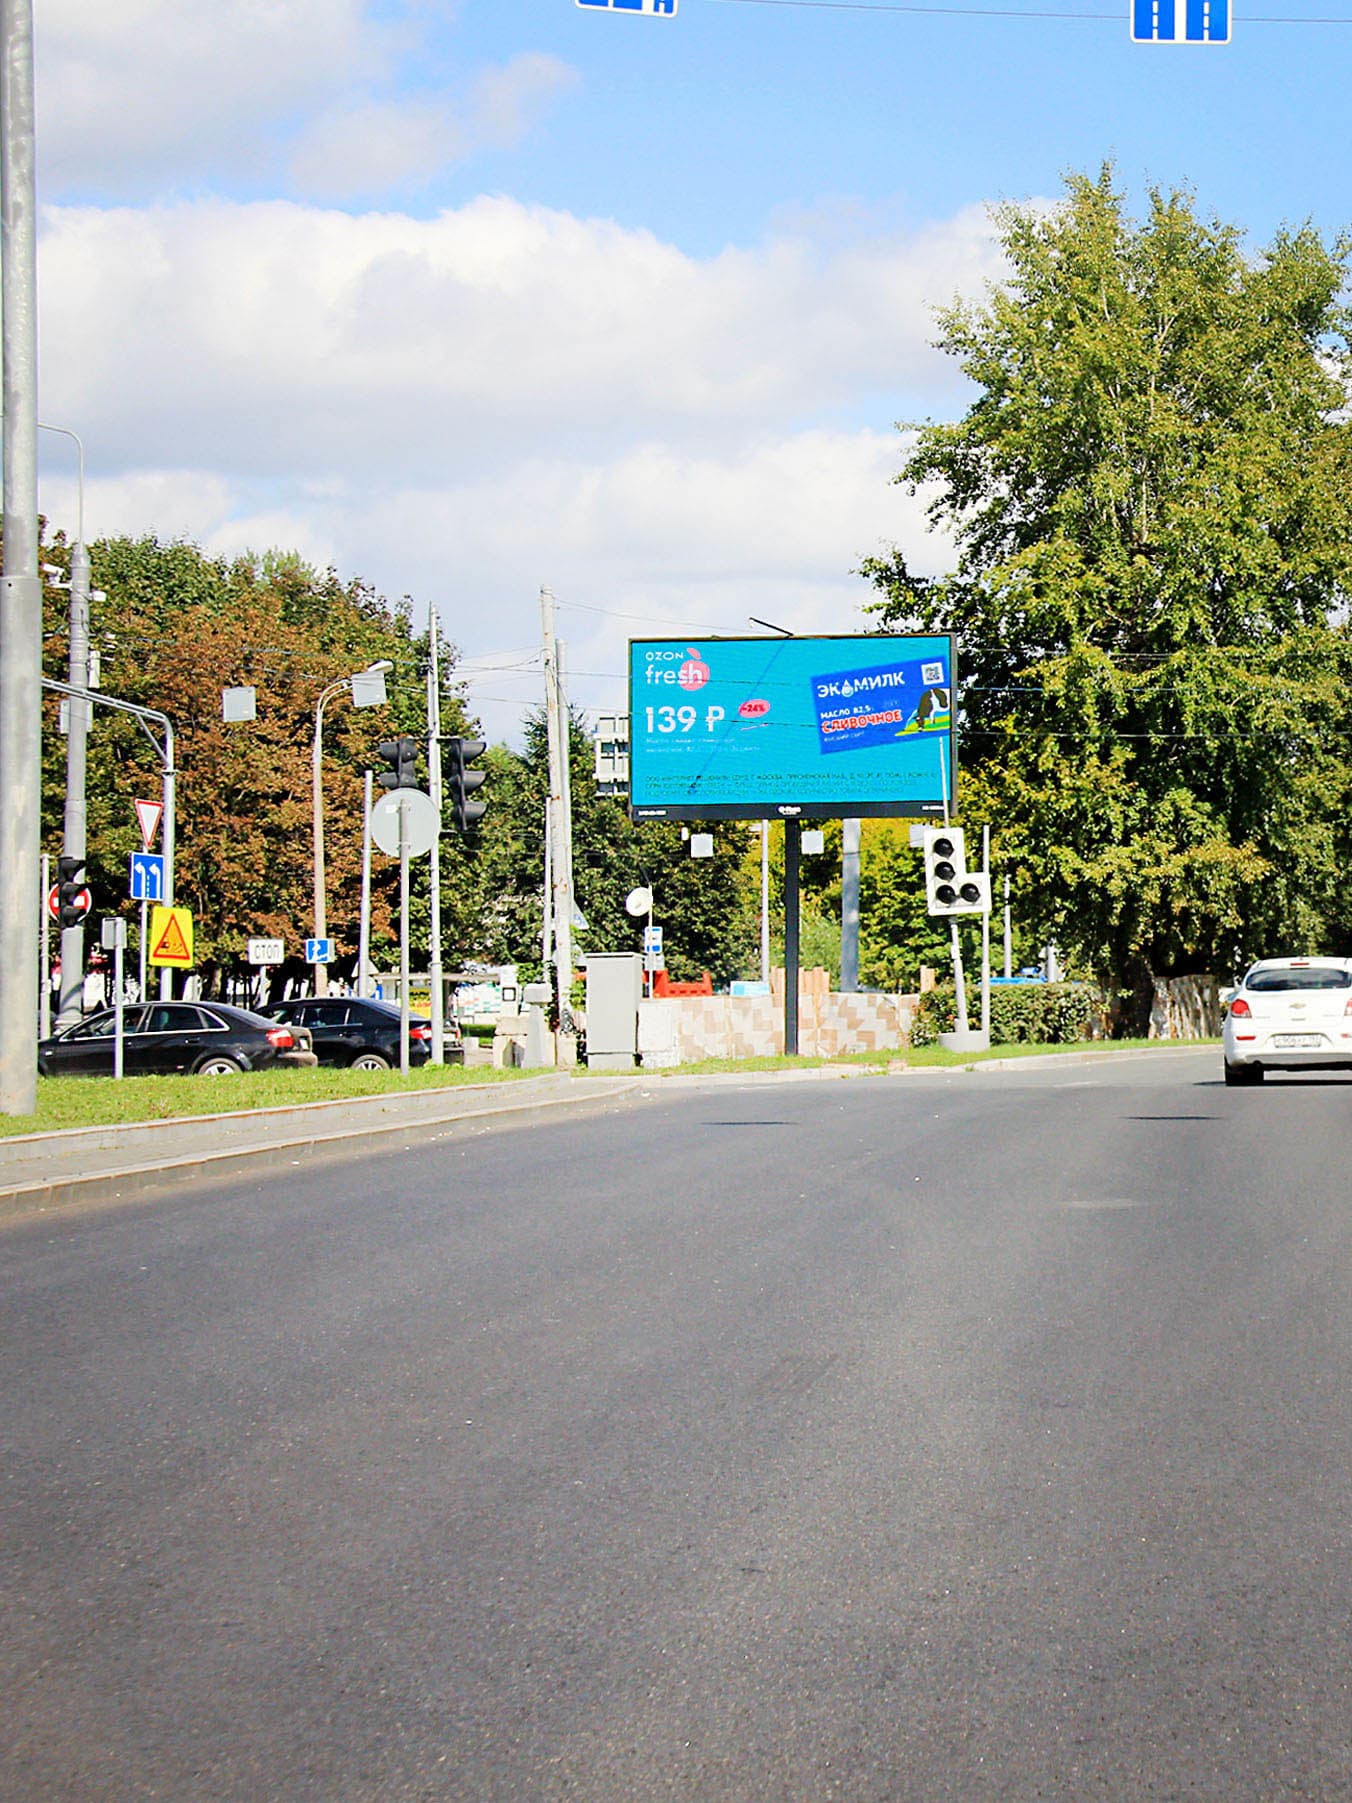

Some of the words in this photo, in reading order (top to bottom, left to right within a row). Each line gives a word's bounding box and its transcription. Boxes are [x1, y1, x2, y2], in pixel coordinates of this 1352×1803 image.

[645, 651, 684, 661] OZON
[645, 663, 703, 684] fresh
[645, 706, 697, 733] 139
[820, 708, 851, 719] МАСЛО
[821, 709, 903, 734] СЛИВОЧНОЕ
[255, 944, 280, 959] СТОП
